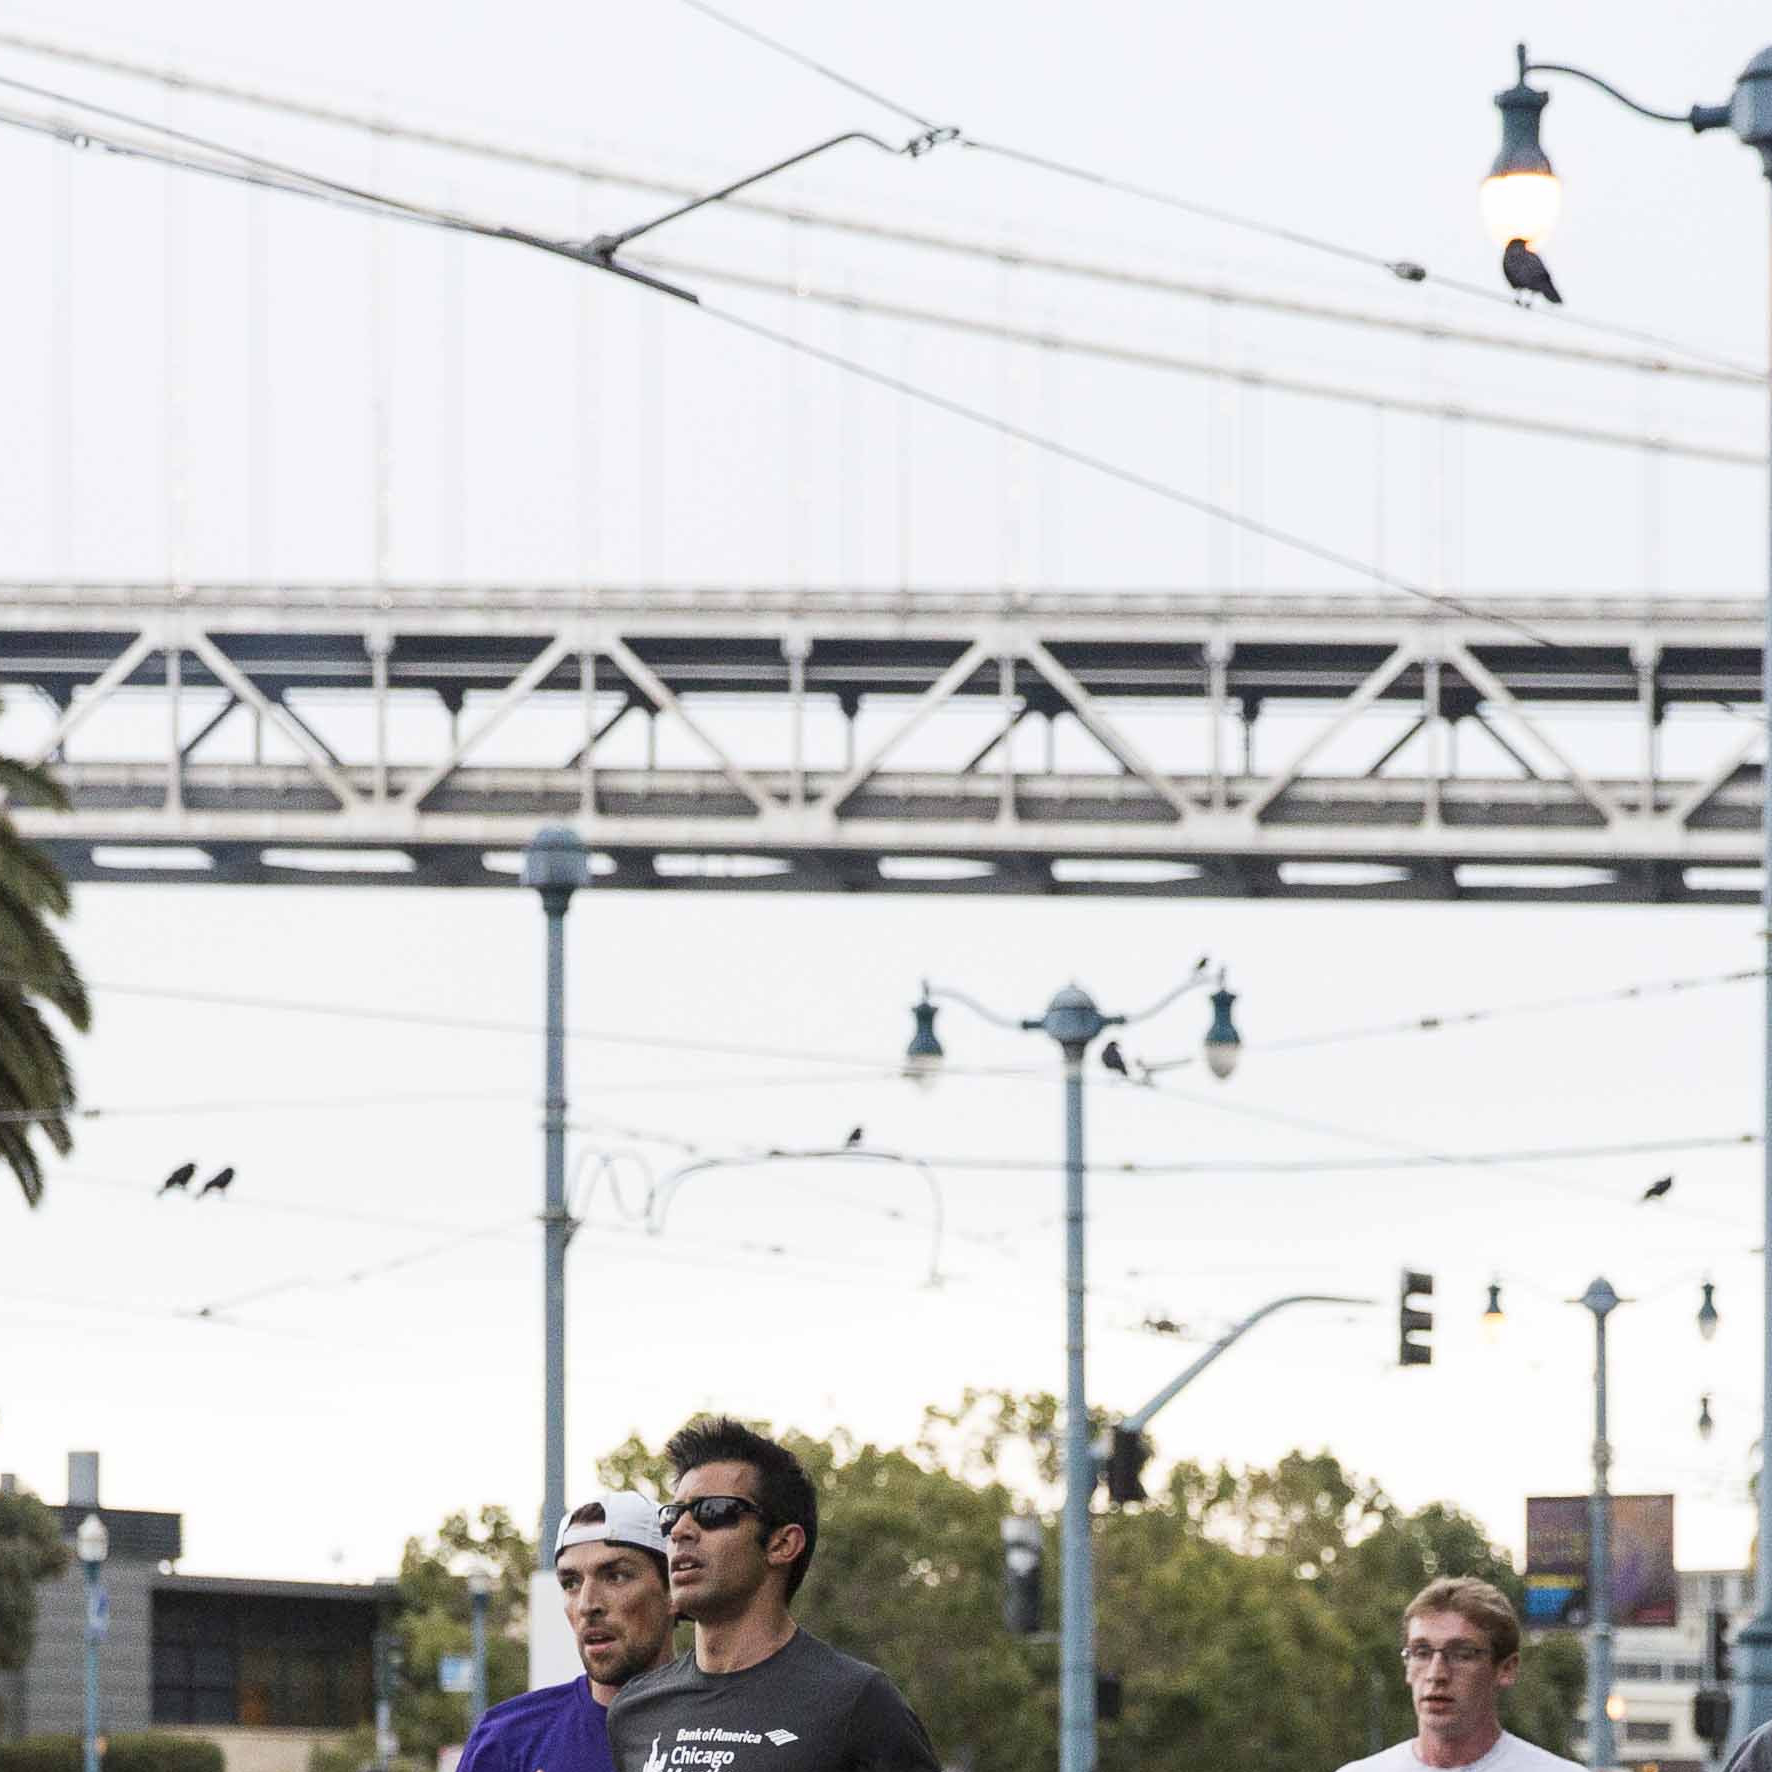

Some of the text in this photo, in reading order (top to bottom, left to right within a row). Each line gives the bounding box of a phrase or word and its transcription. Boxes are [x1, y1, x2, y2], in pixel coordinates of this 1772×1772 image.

[676, 1728, 763, 1744] Bank of America
[670, 1746, 734, 1769] Chicago
